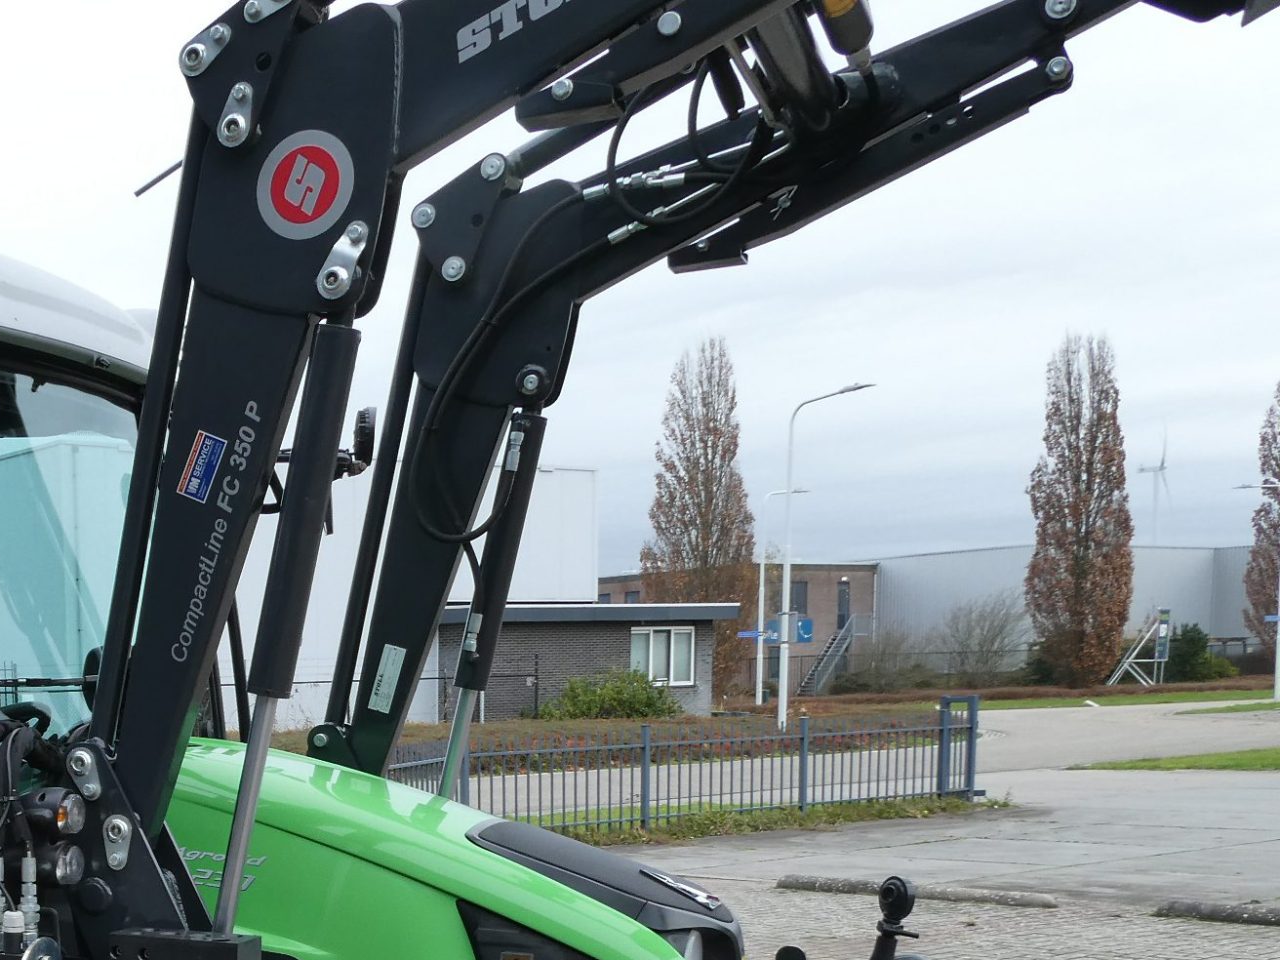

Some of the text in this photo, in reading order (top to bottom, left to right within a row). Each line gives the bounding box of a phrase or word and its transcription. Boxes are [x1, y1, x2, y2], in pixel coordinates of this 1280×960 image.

[457, 0, 570, 63] STO
[193, 437, 213, 478] SERVICE
[171, 517, 228, 662] CompactLine
[217, 475, 241, 514] FC
[229, 429, 257, 472] 350
[245, 400, 263, 423] P
[178, 846, 267, 867] Agrod
